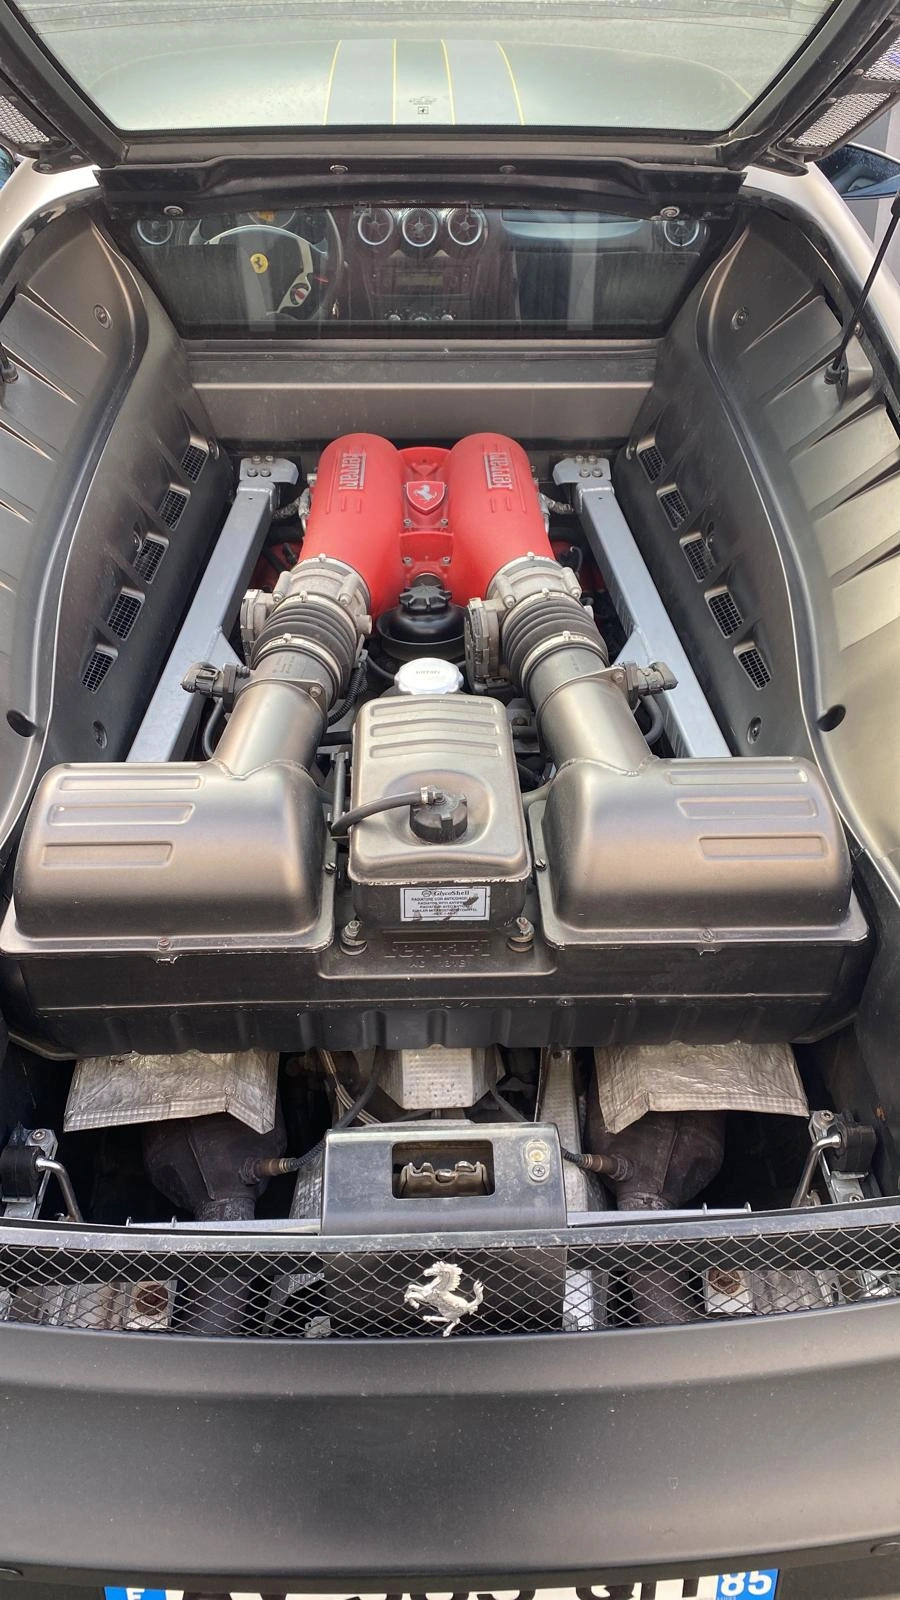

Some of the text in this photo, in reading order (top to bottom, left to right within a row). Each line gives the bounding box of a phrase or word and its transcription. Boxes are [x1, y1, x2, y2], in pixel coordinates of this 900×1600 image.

[338, 452, 366, 490] Ferrari
[484, 452, 512, 490] Ferrari
[720, 1570, 772, 1597] 85
